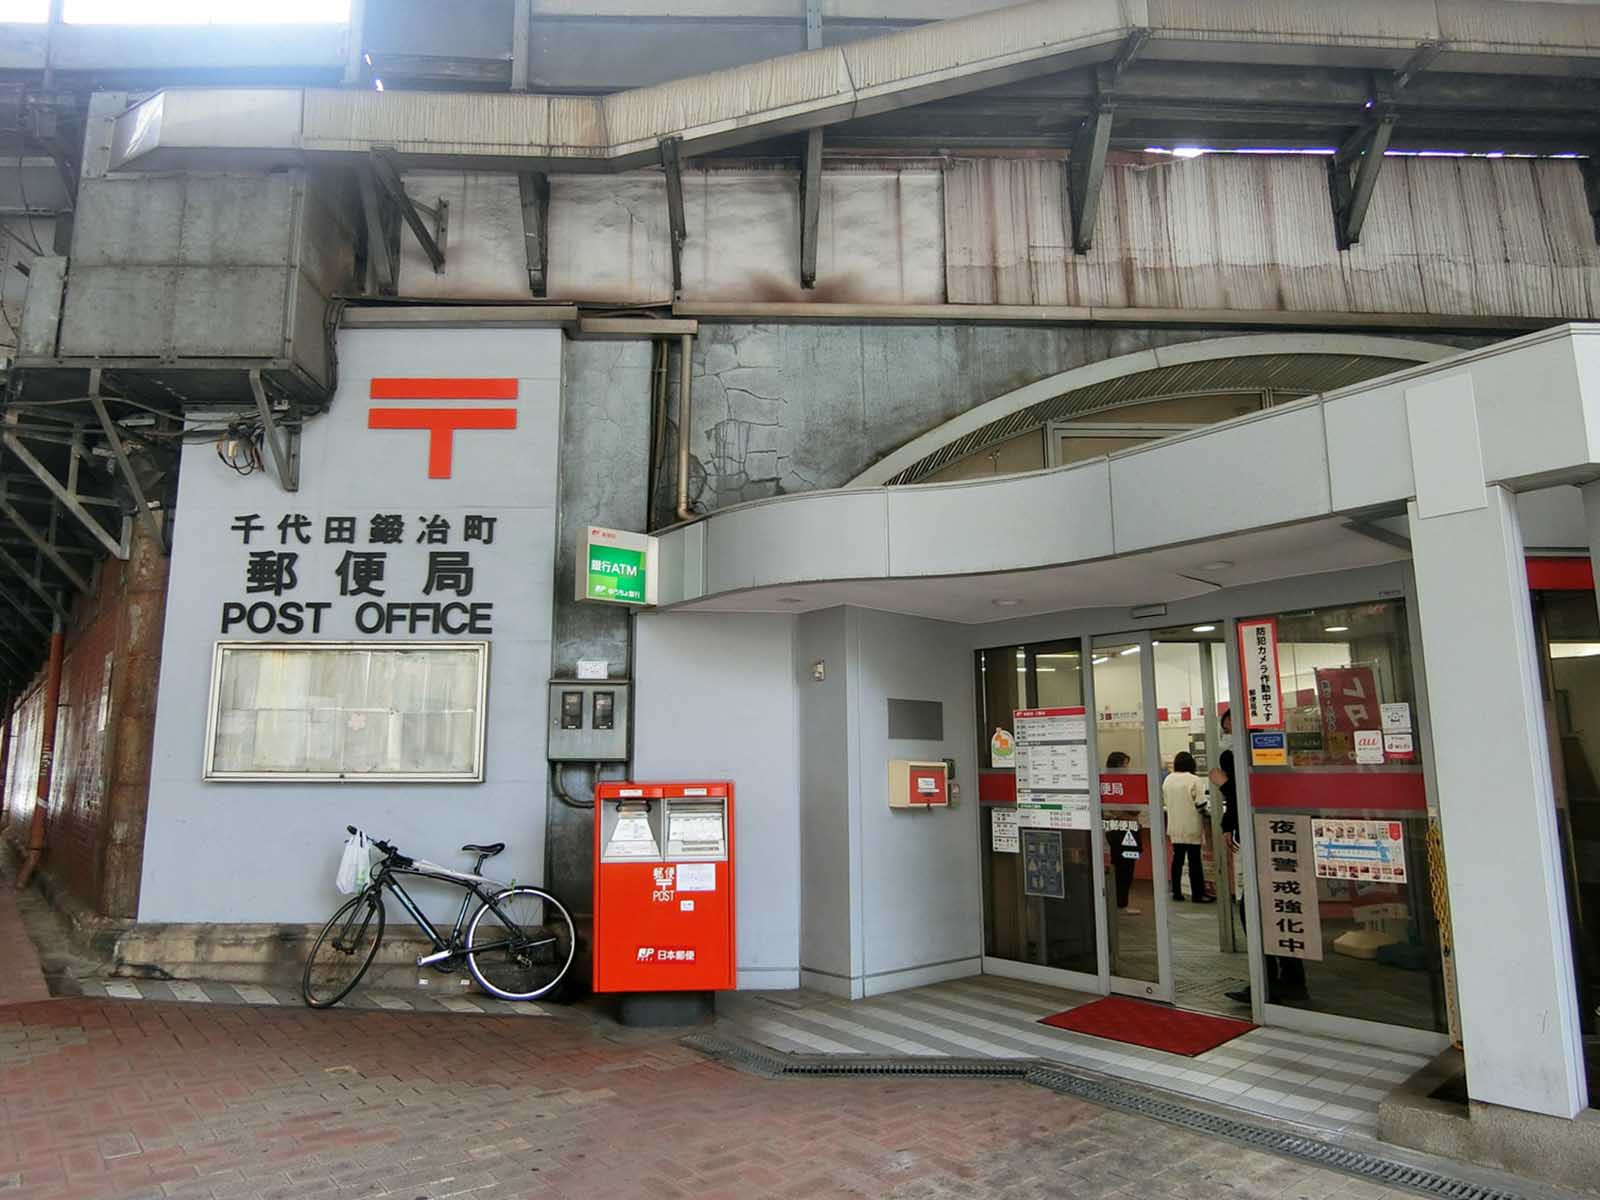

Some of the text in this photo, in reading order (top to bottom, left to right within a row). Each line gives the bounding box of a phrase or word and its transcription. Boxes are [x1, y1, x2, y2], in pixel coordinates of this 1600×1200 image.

[231, 514, 497, 545] 千代田鍛冶町
[246, 550, 474, 597] 郵便局
[591, 559, 638, 577] 銀行ATM
[221, 601, 493, 635] POST OFFICE
[1256, 627, 1273, 722] 防犯カメラ作動中です
[653, 890, 674, 902] POST
[1269, 820, 1305, 953] 夜間警戒強化中
[657, 950, 695, 961] 日本郵便
